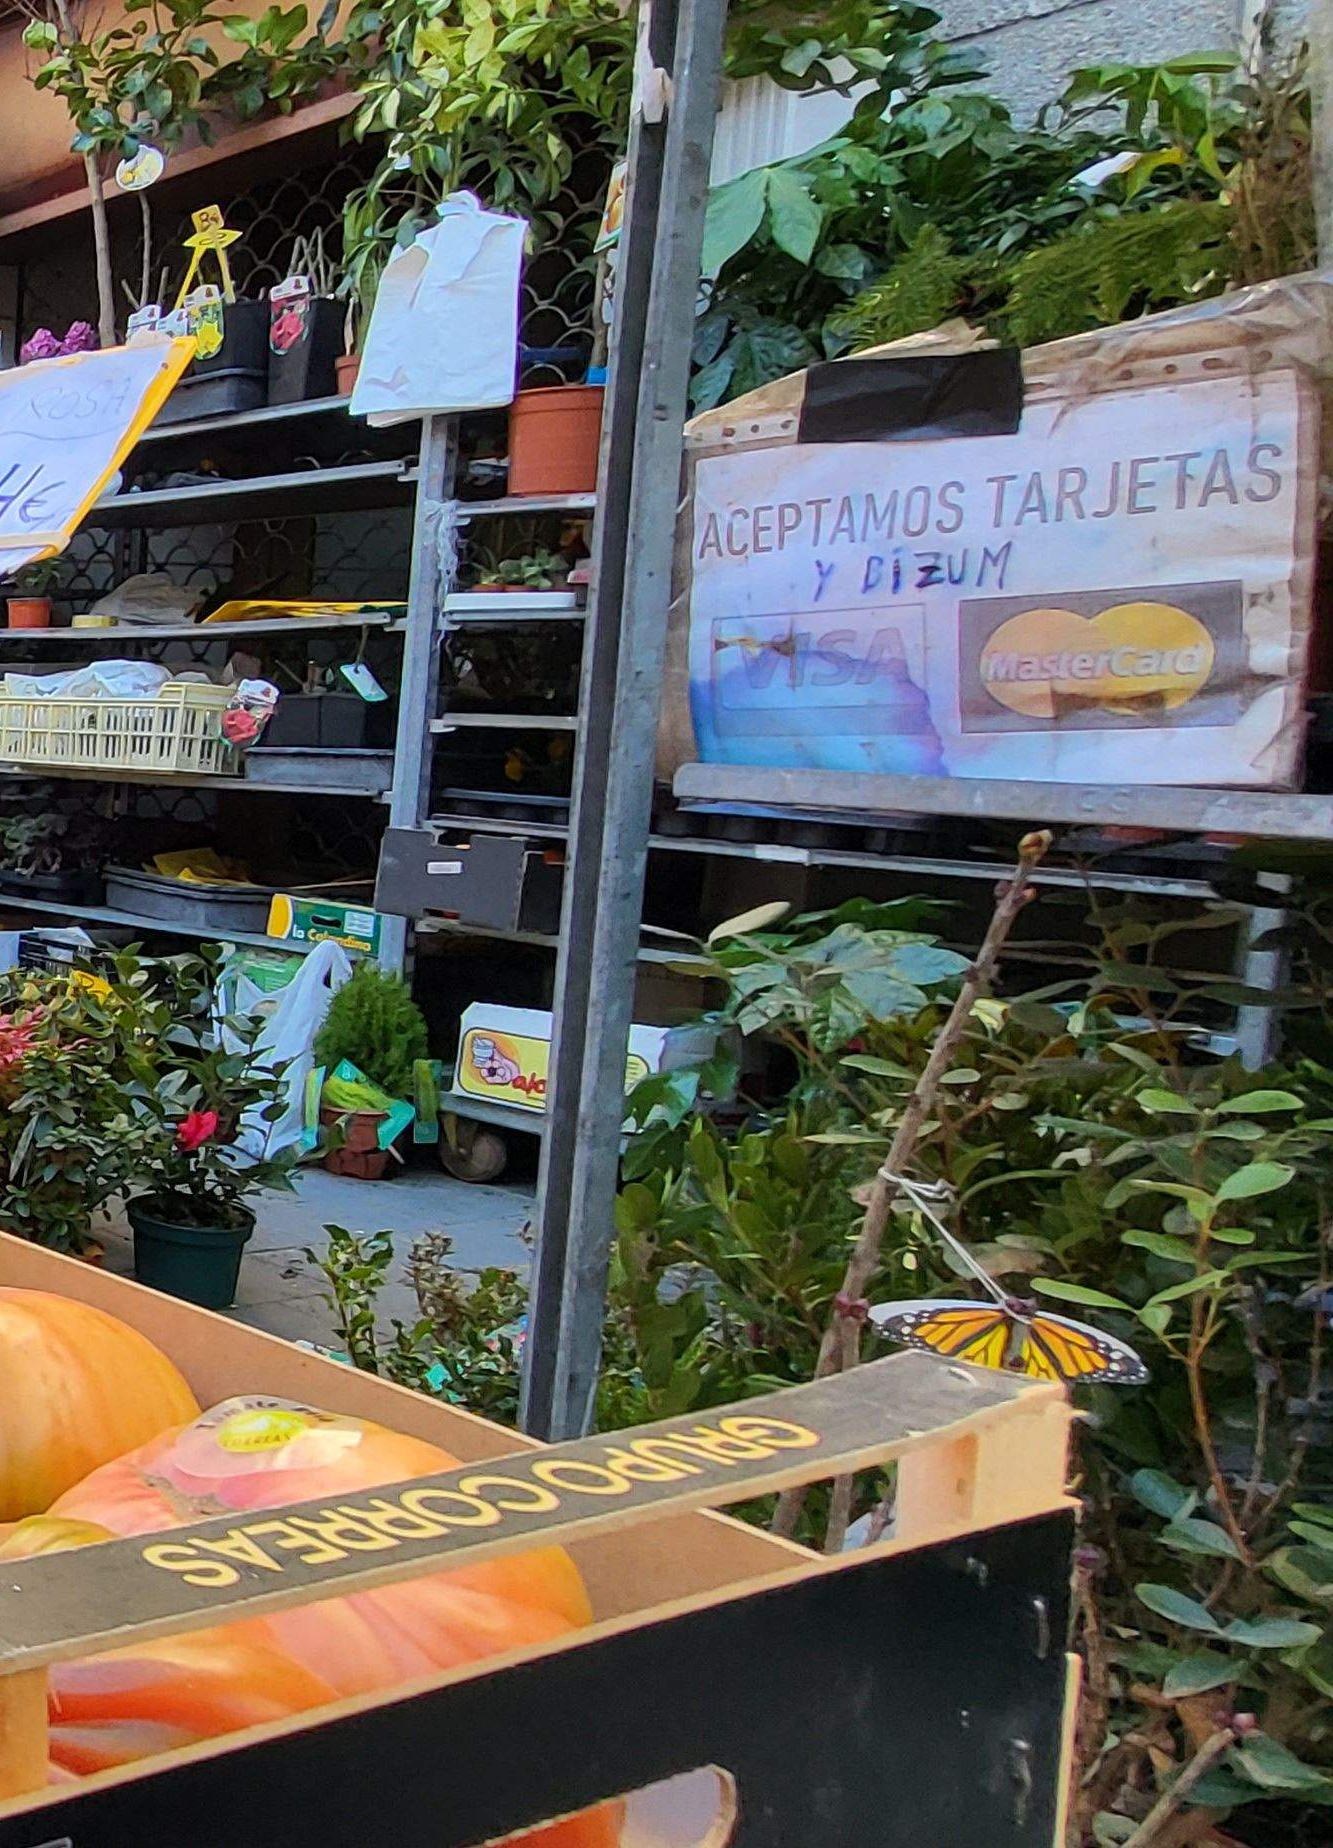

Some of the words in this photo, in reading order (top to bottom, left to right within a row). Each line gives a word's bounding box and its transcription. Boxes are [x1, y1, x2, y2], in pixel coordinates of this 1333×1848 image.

[698, 481, 965, 559] ACEPTAMOS
[986, 443, 1283, 528] TARJETAS
[814, 559, 834, 601] Y
[735, 625, 914, 690] VISA
[987, 645, 1206, 683] MasterCard
[531, 1415, 821, 1497] GRUPO
[141, 1472, 561, 1588] CORREAS
